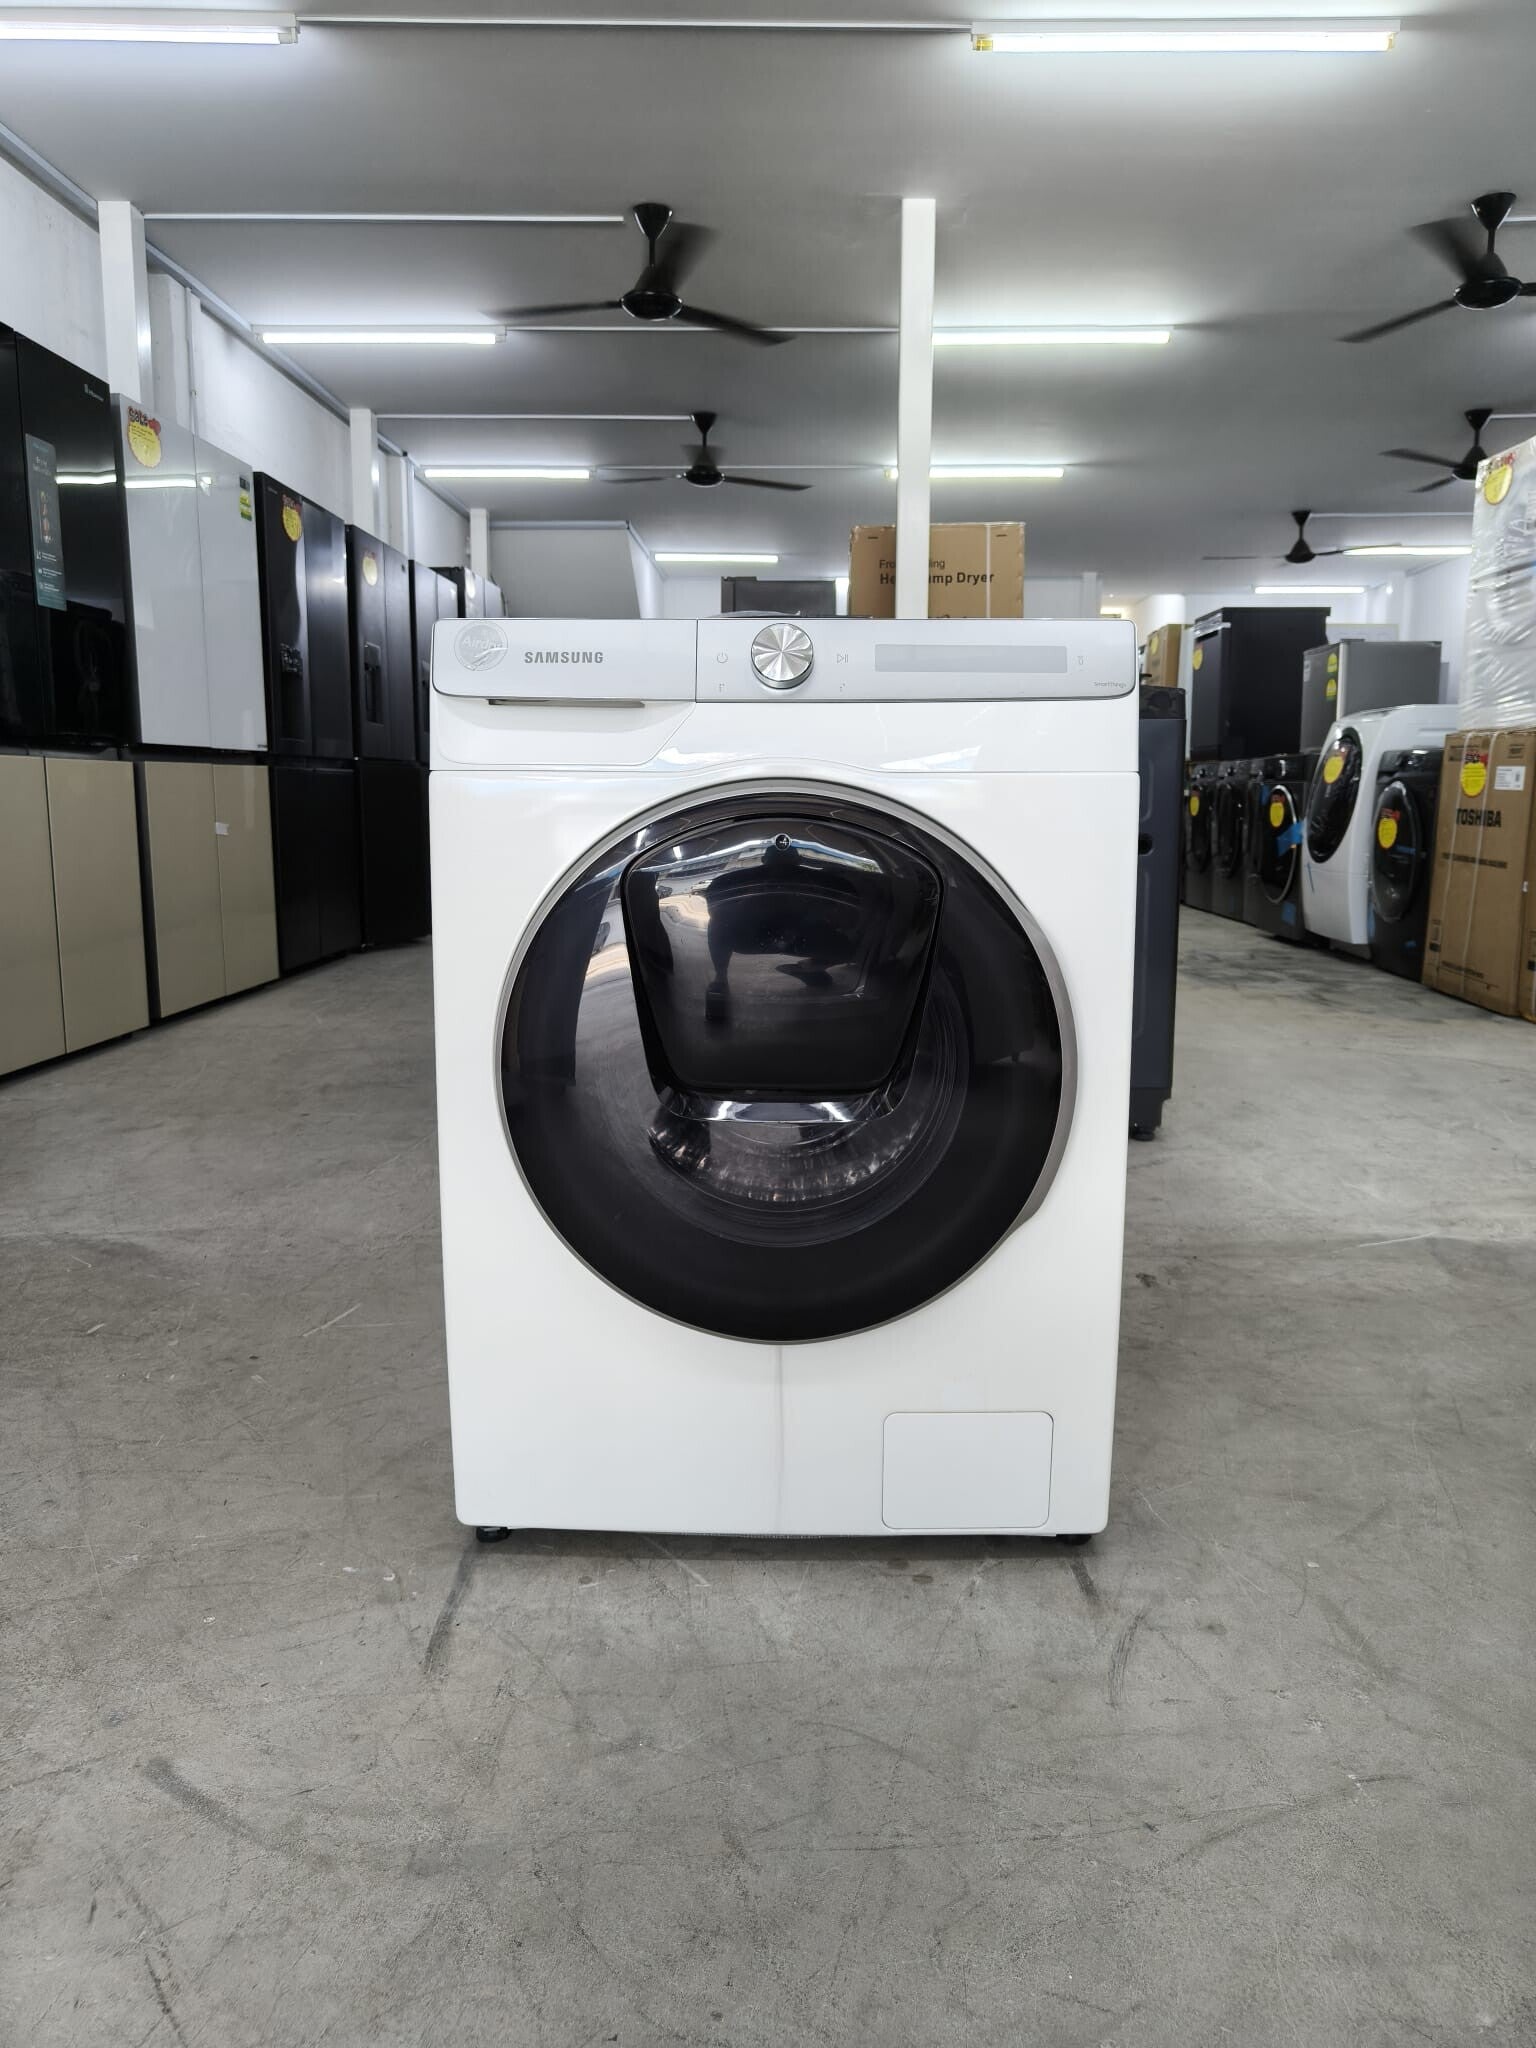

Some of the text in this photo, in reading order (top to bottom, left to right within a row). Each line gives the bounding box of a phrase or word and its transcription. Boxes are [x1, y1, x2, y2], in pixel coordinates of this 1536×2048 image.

[957, 572, 995, 586] Dryer
[524, 651, 604, 664] SAMSUNG
[1456, 807, 1502, 828] TOSHIBA
